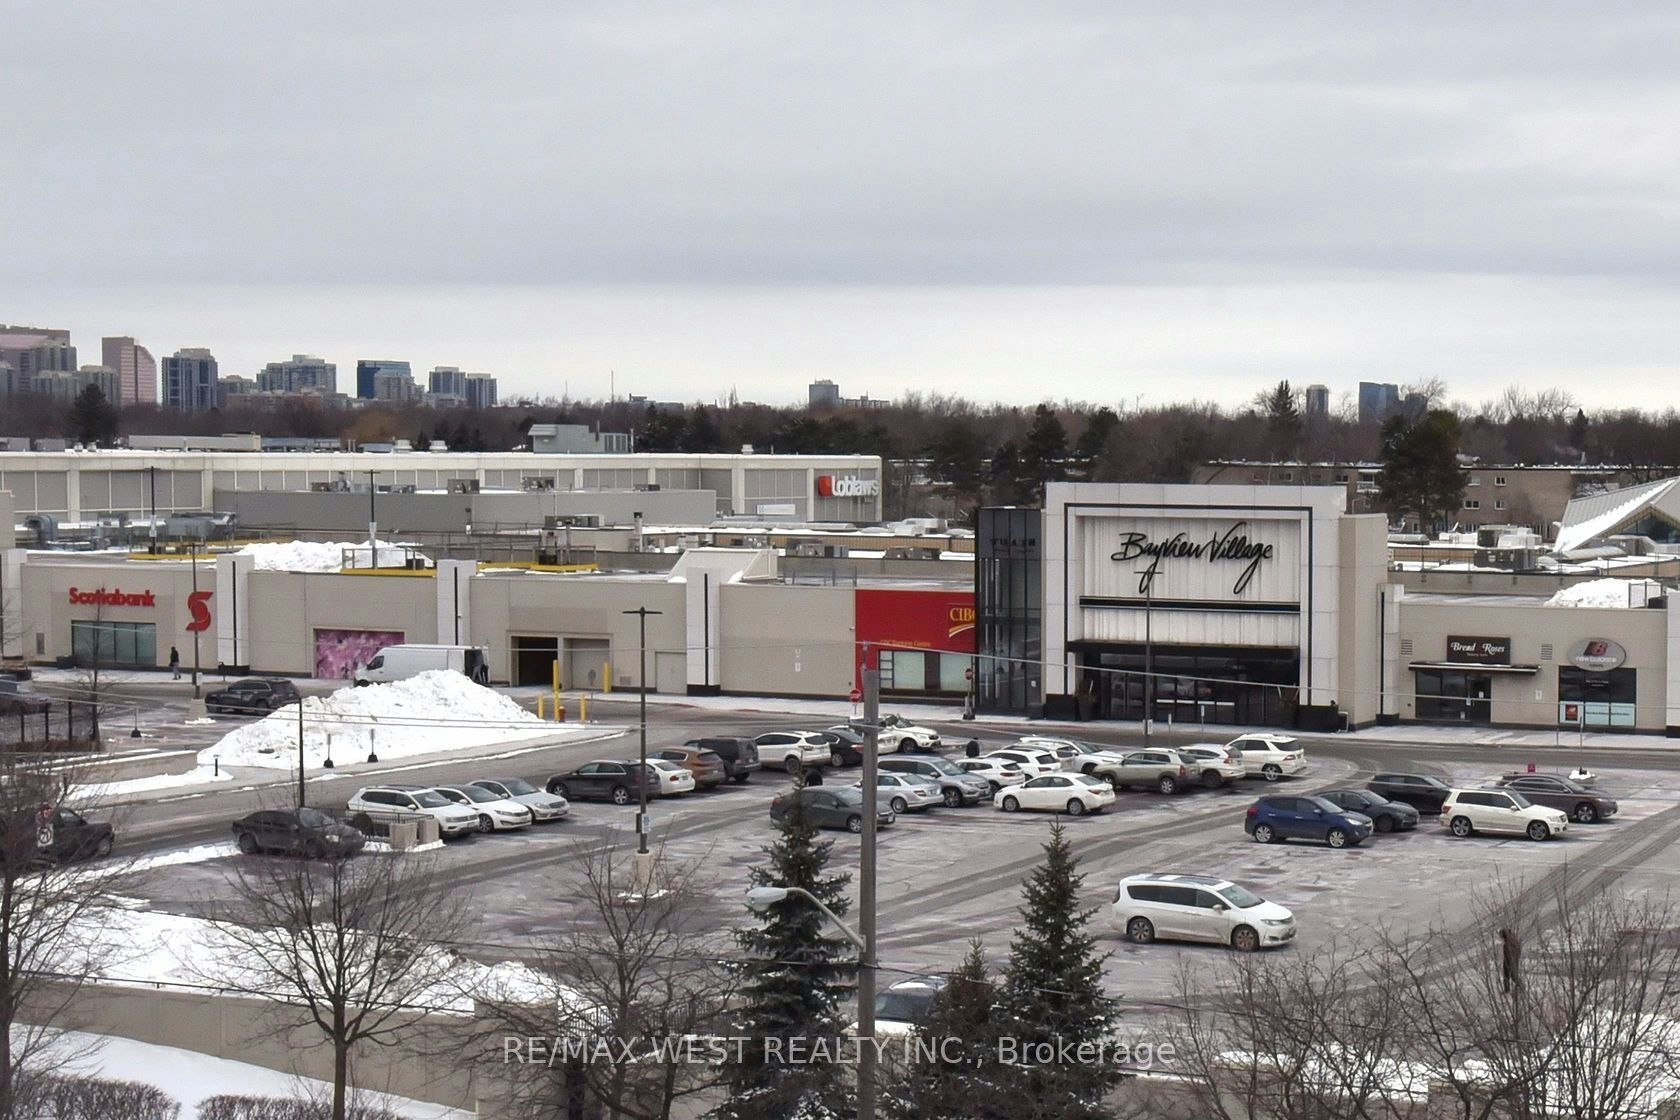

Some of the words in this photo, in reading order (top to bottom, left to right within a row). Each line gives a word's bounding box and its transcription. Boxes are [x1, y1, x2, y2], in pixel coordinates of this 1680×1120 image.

[831, 475, 880, 497] Loblaws
[1202, 521, 1273, 594] Village
[69, 587, 155, 607] Scotiabank
[1451, 641, 1476, 651] Bread
[1482, 643, 1505, 655] Roses
